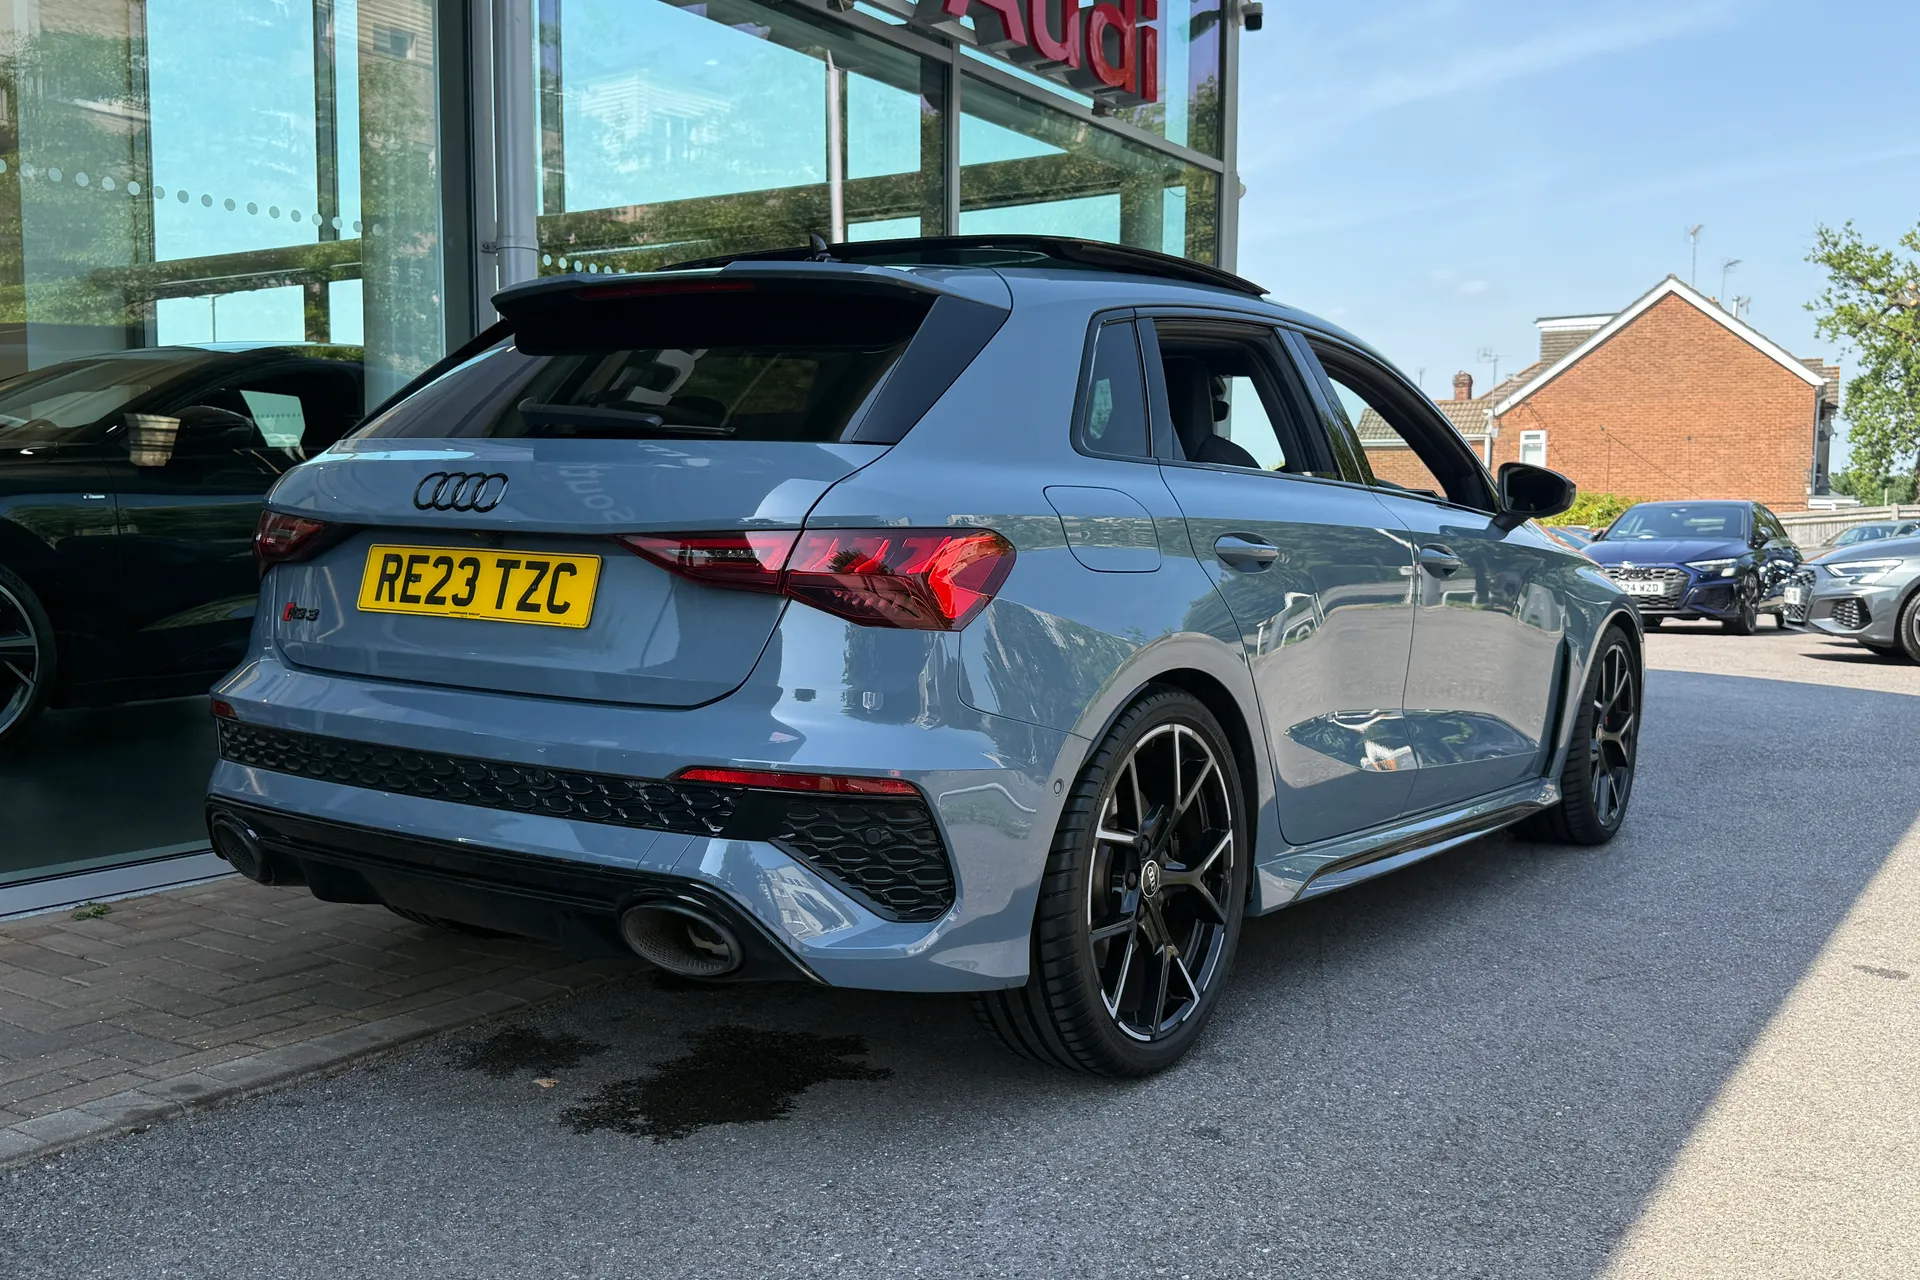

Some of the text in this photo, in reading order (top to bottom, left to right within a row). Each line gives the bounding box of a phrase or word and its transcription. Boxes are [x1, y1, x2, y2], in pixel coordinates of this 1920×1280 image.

[375, 553, 578, 615] RE23 TZC
[1620, 583, 1659, 592] 24 WZD
